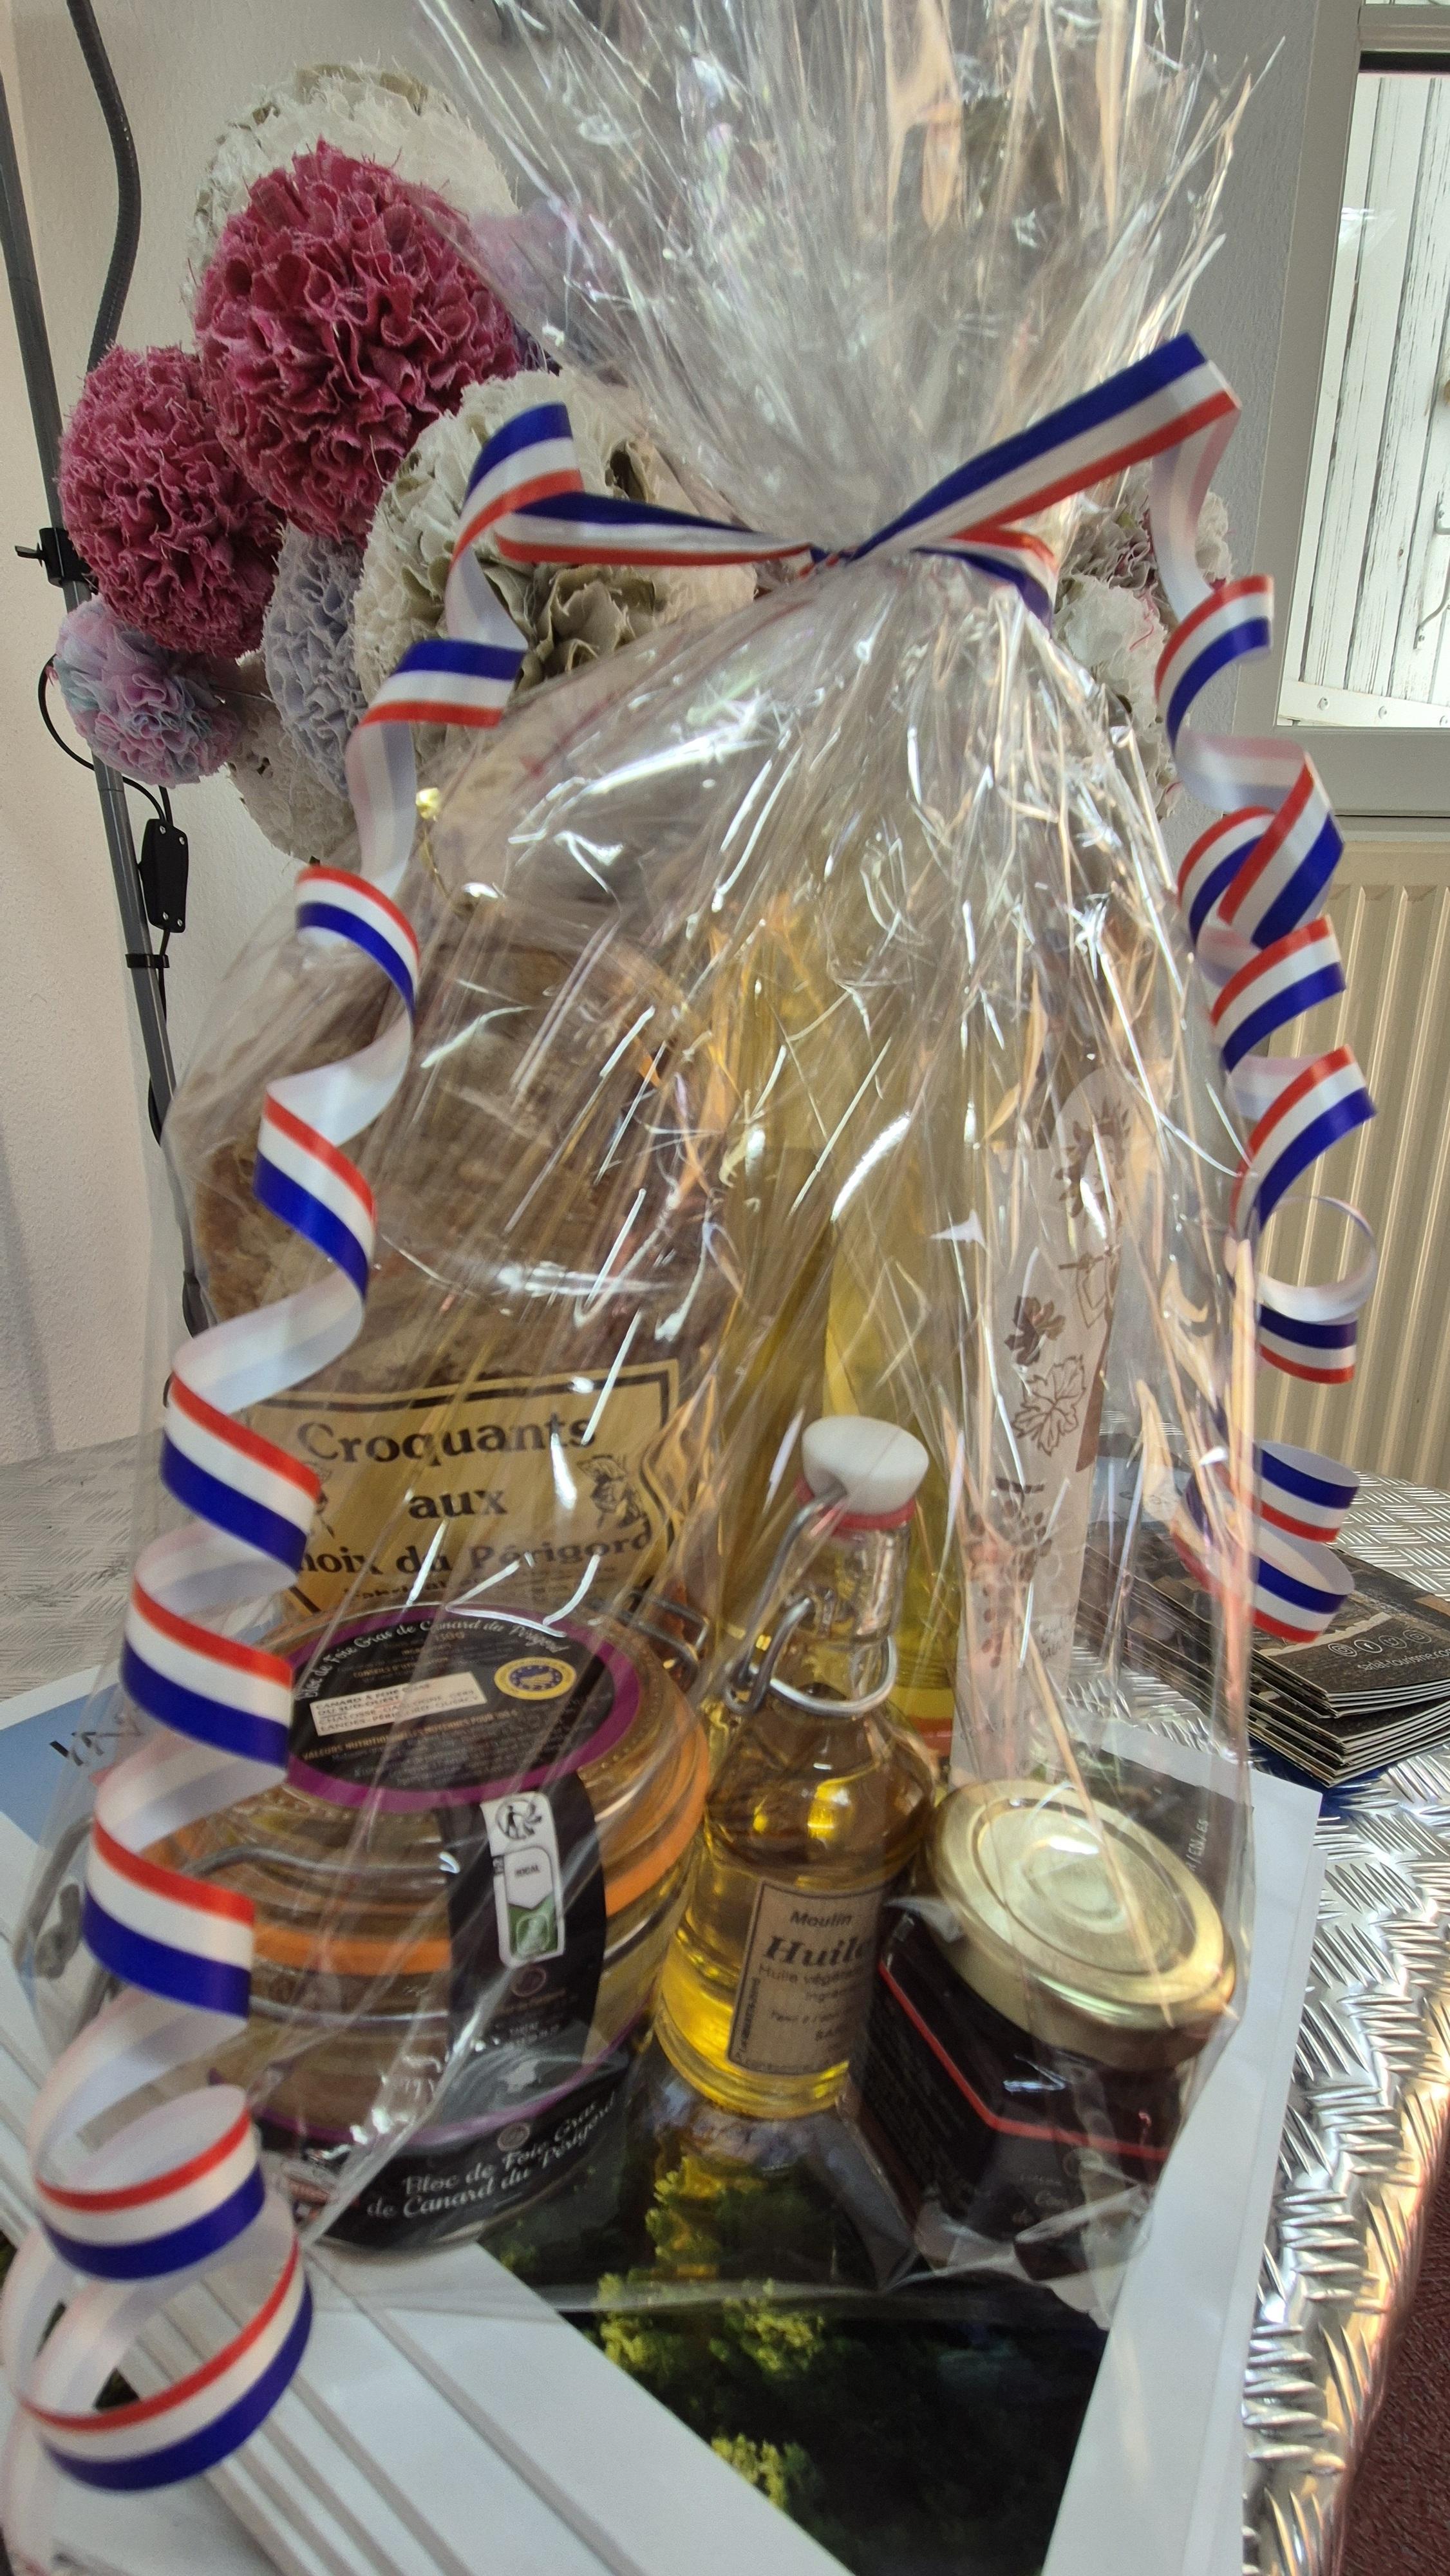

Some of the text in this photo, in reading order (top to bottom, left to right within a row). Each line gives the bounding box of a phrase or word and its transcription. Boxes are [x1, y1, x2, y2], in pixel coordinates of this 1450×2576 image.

[297, 1412, 595, 1467] Croquants
[408, 1490, 507, 1519] aux
[395, 1545, 452, 1573] du
[323, 1647, 357, 1663] Foie
[353, 1630, 393, 1648] Gras
[396, 1624, 416, 1636] de
[483, 1620, 506, 1633] du
[790, 1909, 854, 1927] Moulin
[402, 2101, 598, 2195] Bloc de Foie Gras
[366, 2197, 396, 2219] de
[402, 2177, 495, 2219] Canard
[501, 2168, 531, 2190] du
